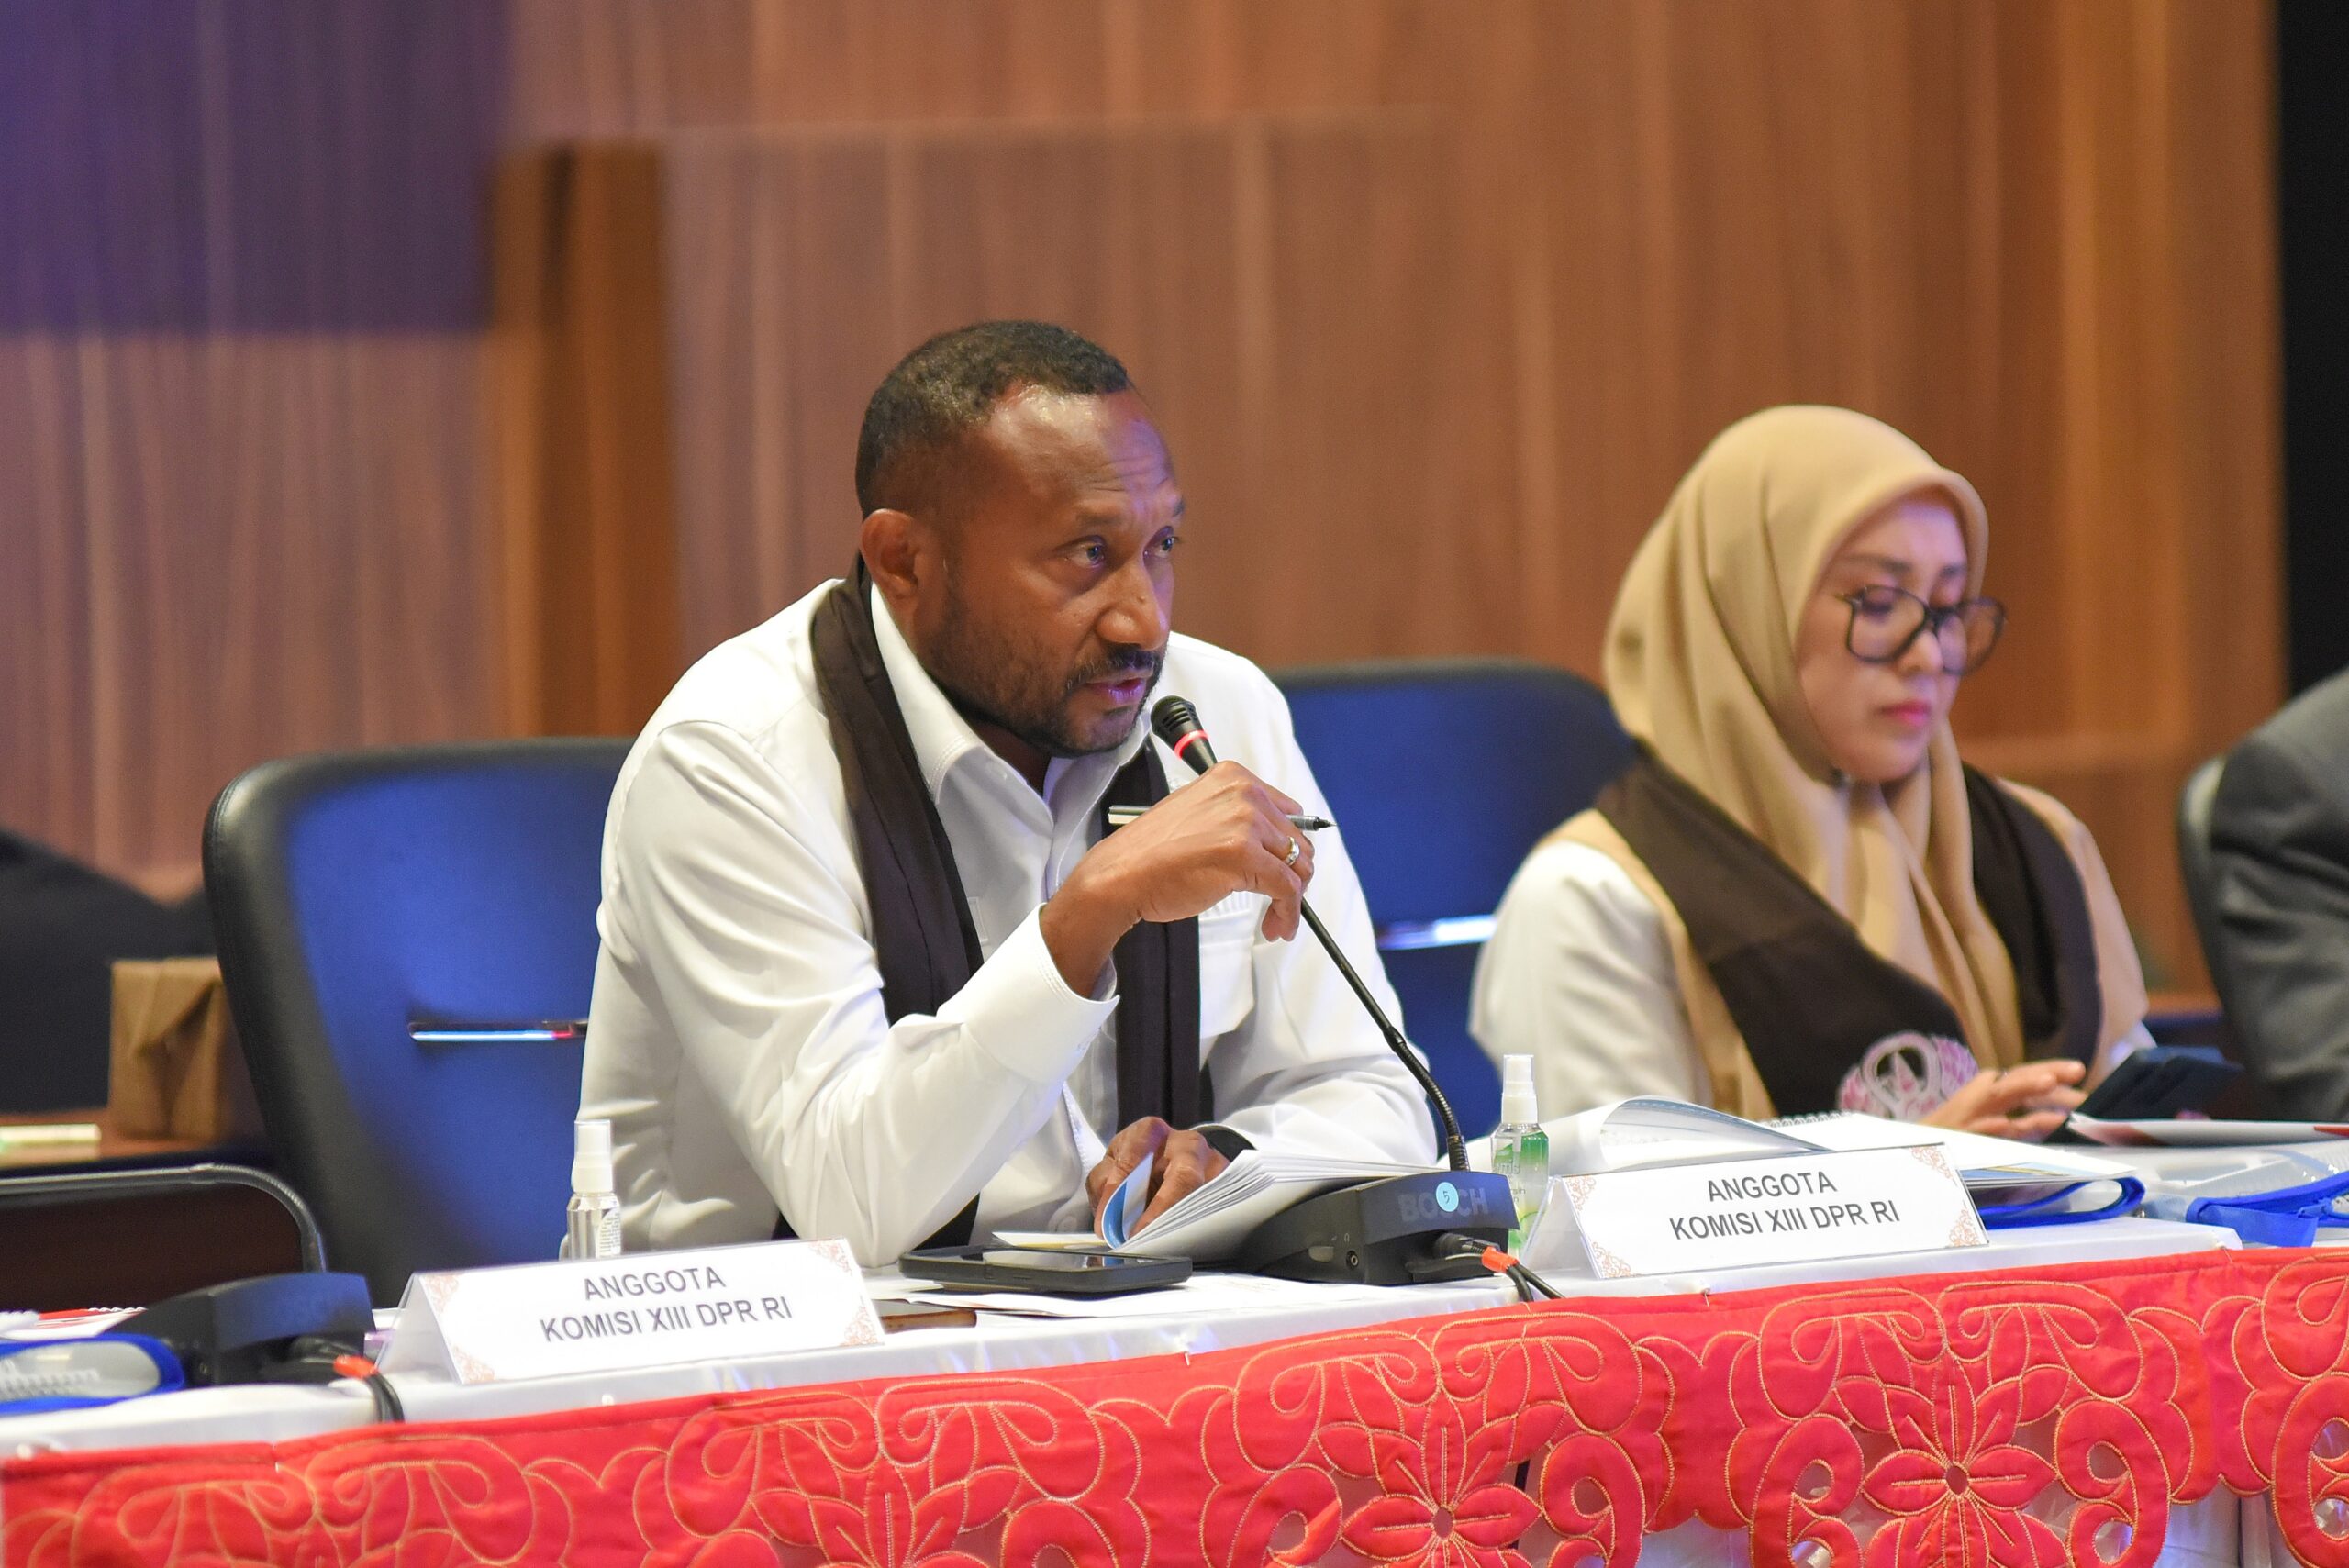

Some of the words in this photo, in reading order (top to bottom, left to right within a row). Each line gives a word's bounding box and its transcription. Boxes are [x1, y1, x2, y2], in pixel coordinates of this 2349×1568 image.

[1708, 1171, 1838, 1202] ANGGOTA
[1397, 1188, 1488, 1222] BOCH
[1669, 1210, 1764, 1240] KOMISI
[1765, 1207, 1808, 1233] XIII
[1810, 1202, 1869, 1229] DPR
[1870, 1199, 1900, 1224] RI
[584, 1266, 727, 1300] ANGGOTA
[540, 1310, 642, 1342] KOMISI
[646, 1305, 692, 1332] XIII
[696, 1299, 758, 1327] DPR
[761, 1296, 793, 1322] RI
